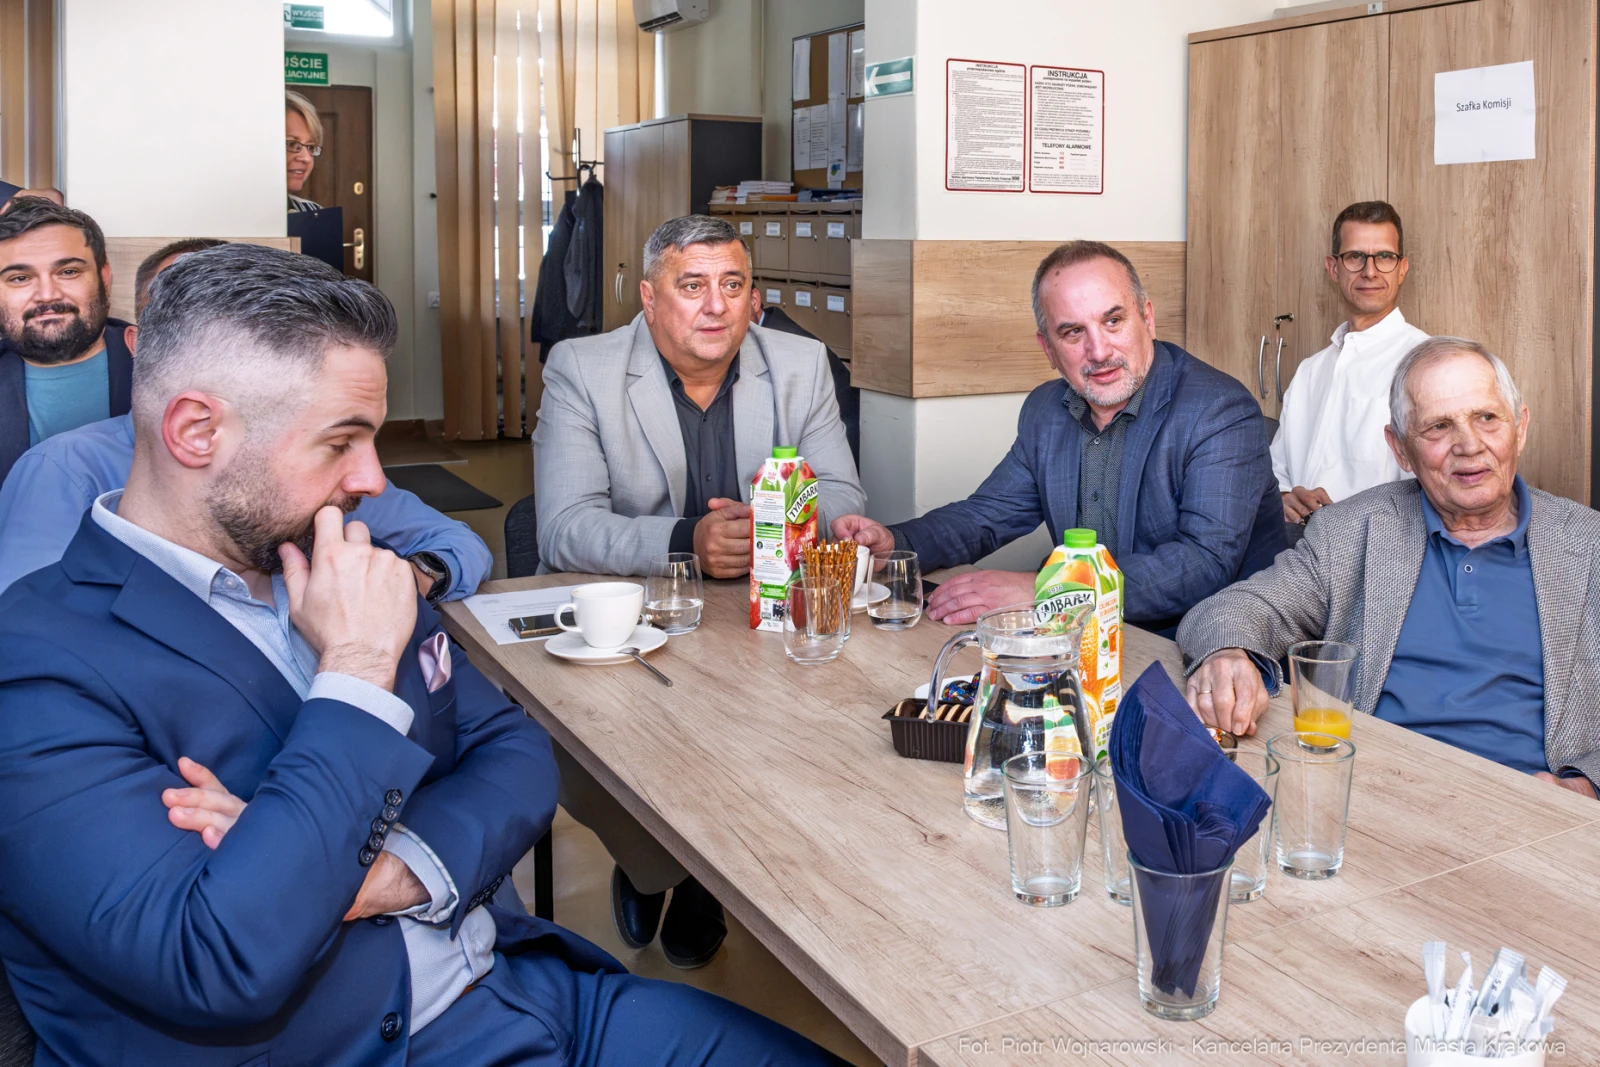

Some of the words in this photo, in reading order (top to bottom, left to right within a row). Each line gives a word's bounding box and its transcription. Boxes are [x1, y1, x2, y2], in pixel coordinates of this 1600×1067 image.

[284, 54, 323, 69] JŚCIE
[284, 70, 326, 80] UACYJNE
[1047, 70, 1088, 79] INSTRUKCJA
[1456, 101, 1480, 112] Szafka
[1482, 98, 1512, 109] Komisji
[788, 484, 818, 518] TYMBARK
[1048, 584, 1063, 594] 1936
